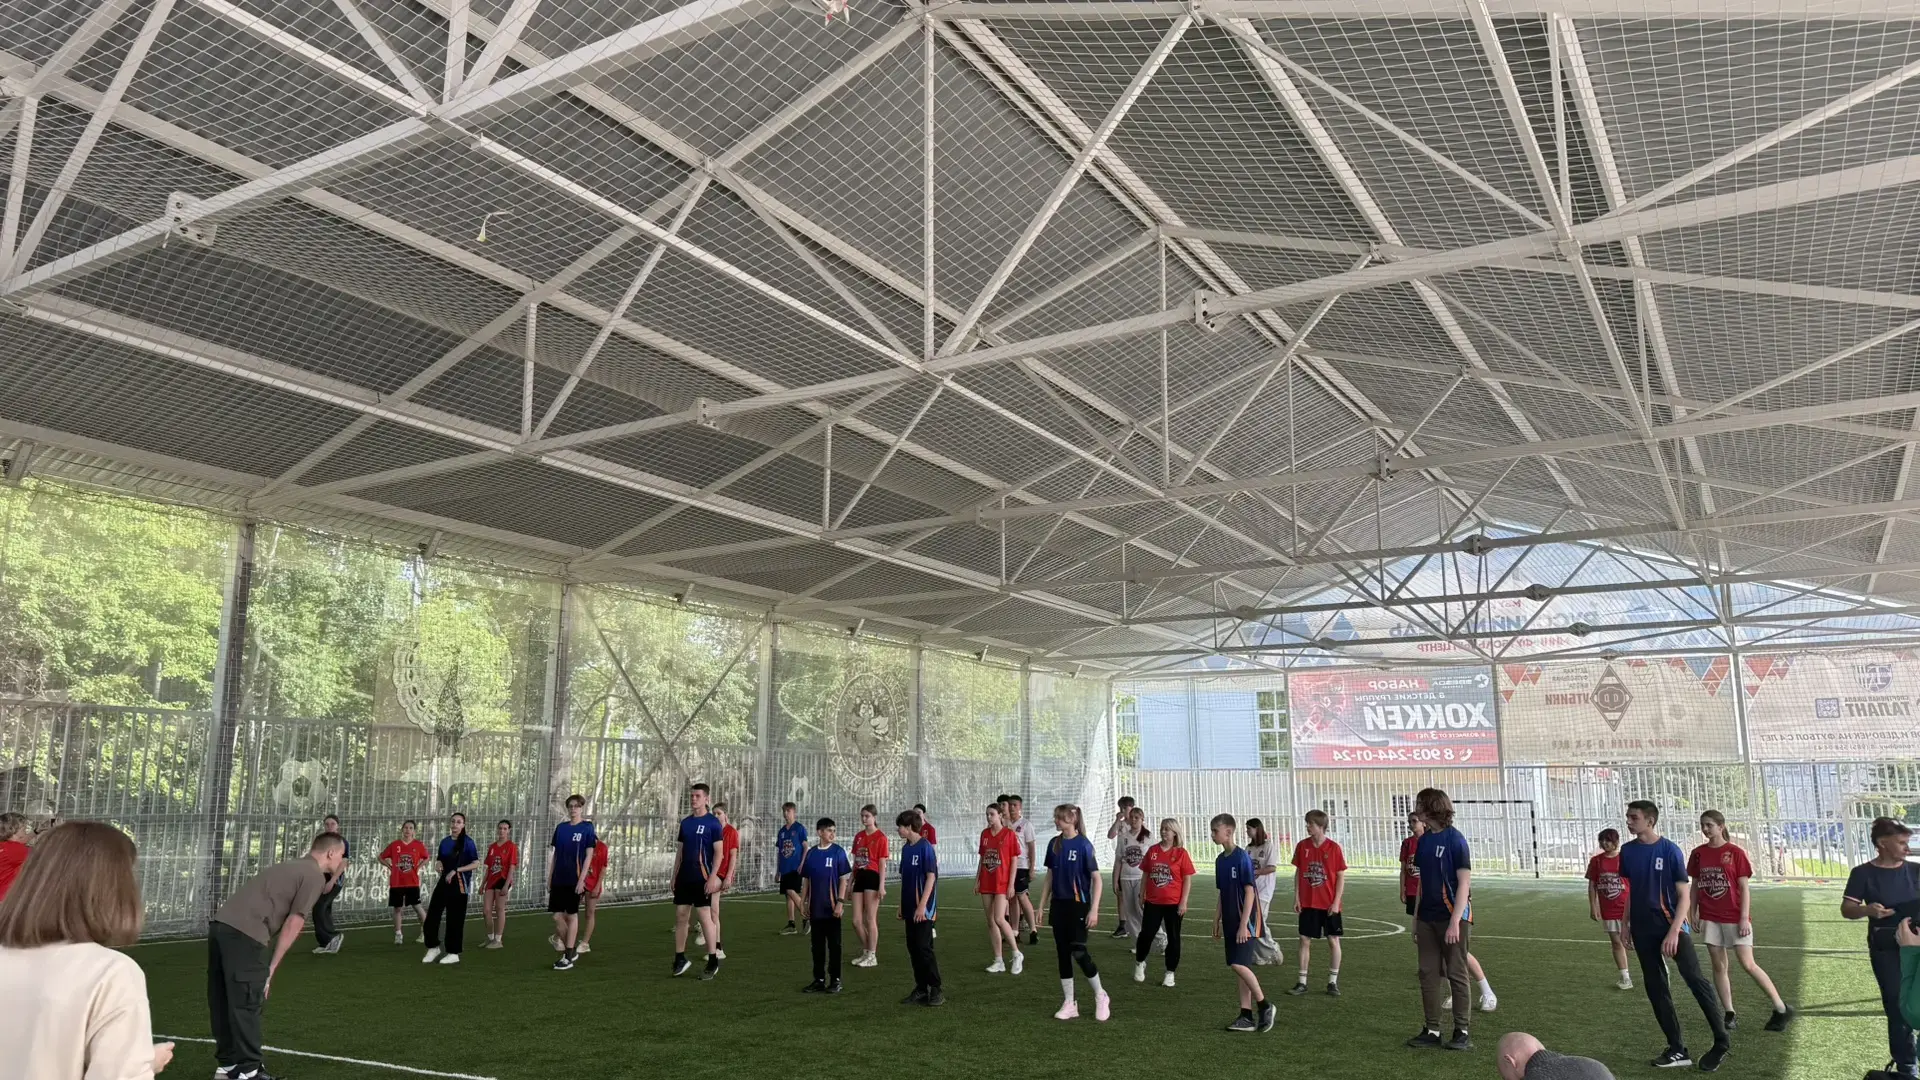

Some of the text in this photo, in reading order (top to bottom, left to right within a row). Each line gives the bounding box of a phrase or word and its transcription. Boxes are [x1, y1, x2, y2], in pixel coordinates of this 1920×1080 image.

[696, 825, 705, 834] 13
[572, 833, 582, 842] 20
[1068, 849, 1077, 860] 15
[1151, 852, 1158, 861] 15
[1435, 845, 1445, 858] 17
[825, 857, 833, 867] 11
[911, 855, 919, 865] 12
[1654, 857, 1663, 870] 8
[1230, 868, 1236, 878] 6
